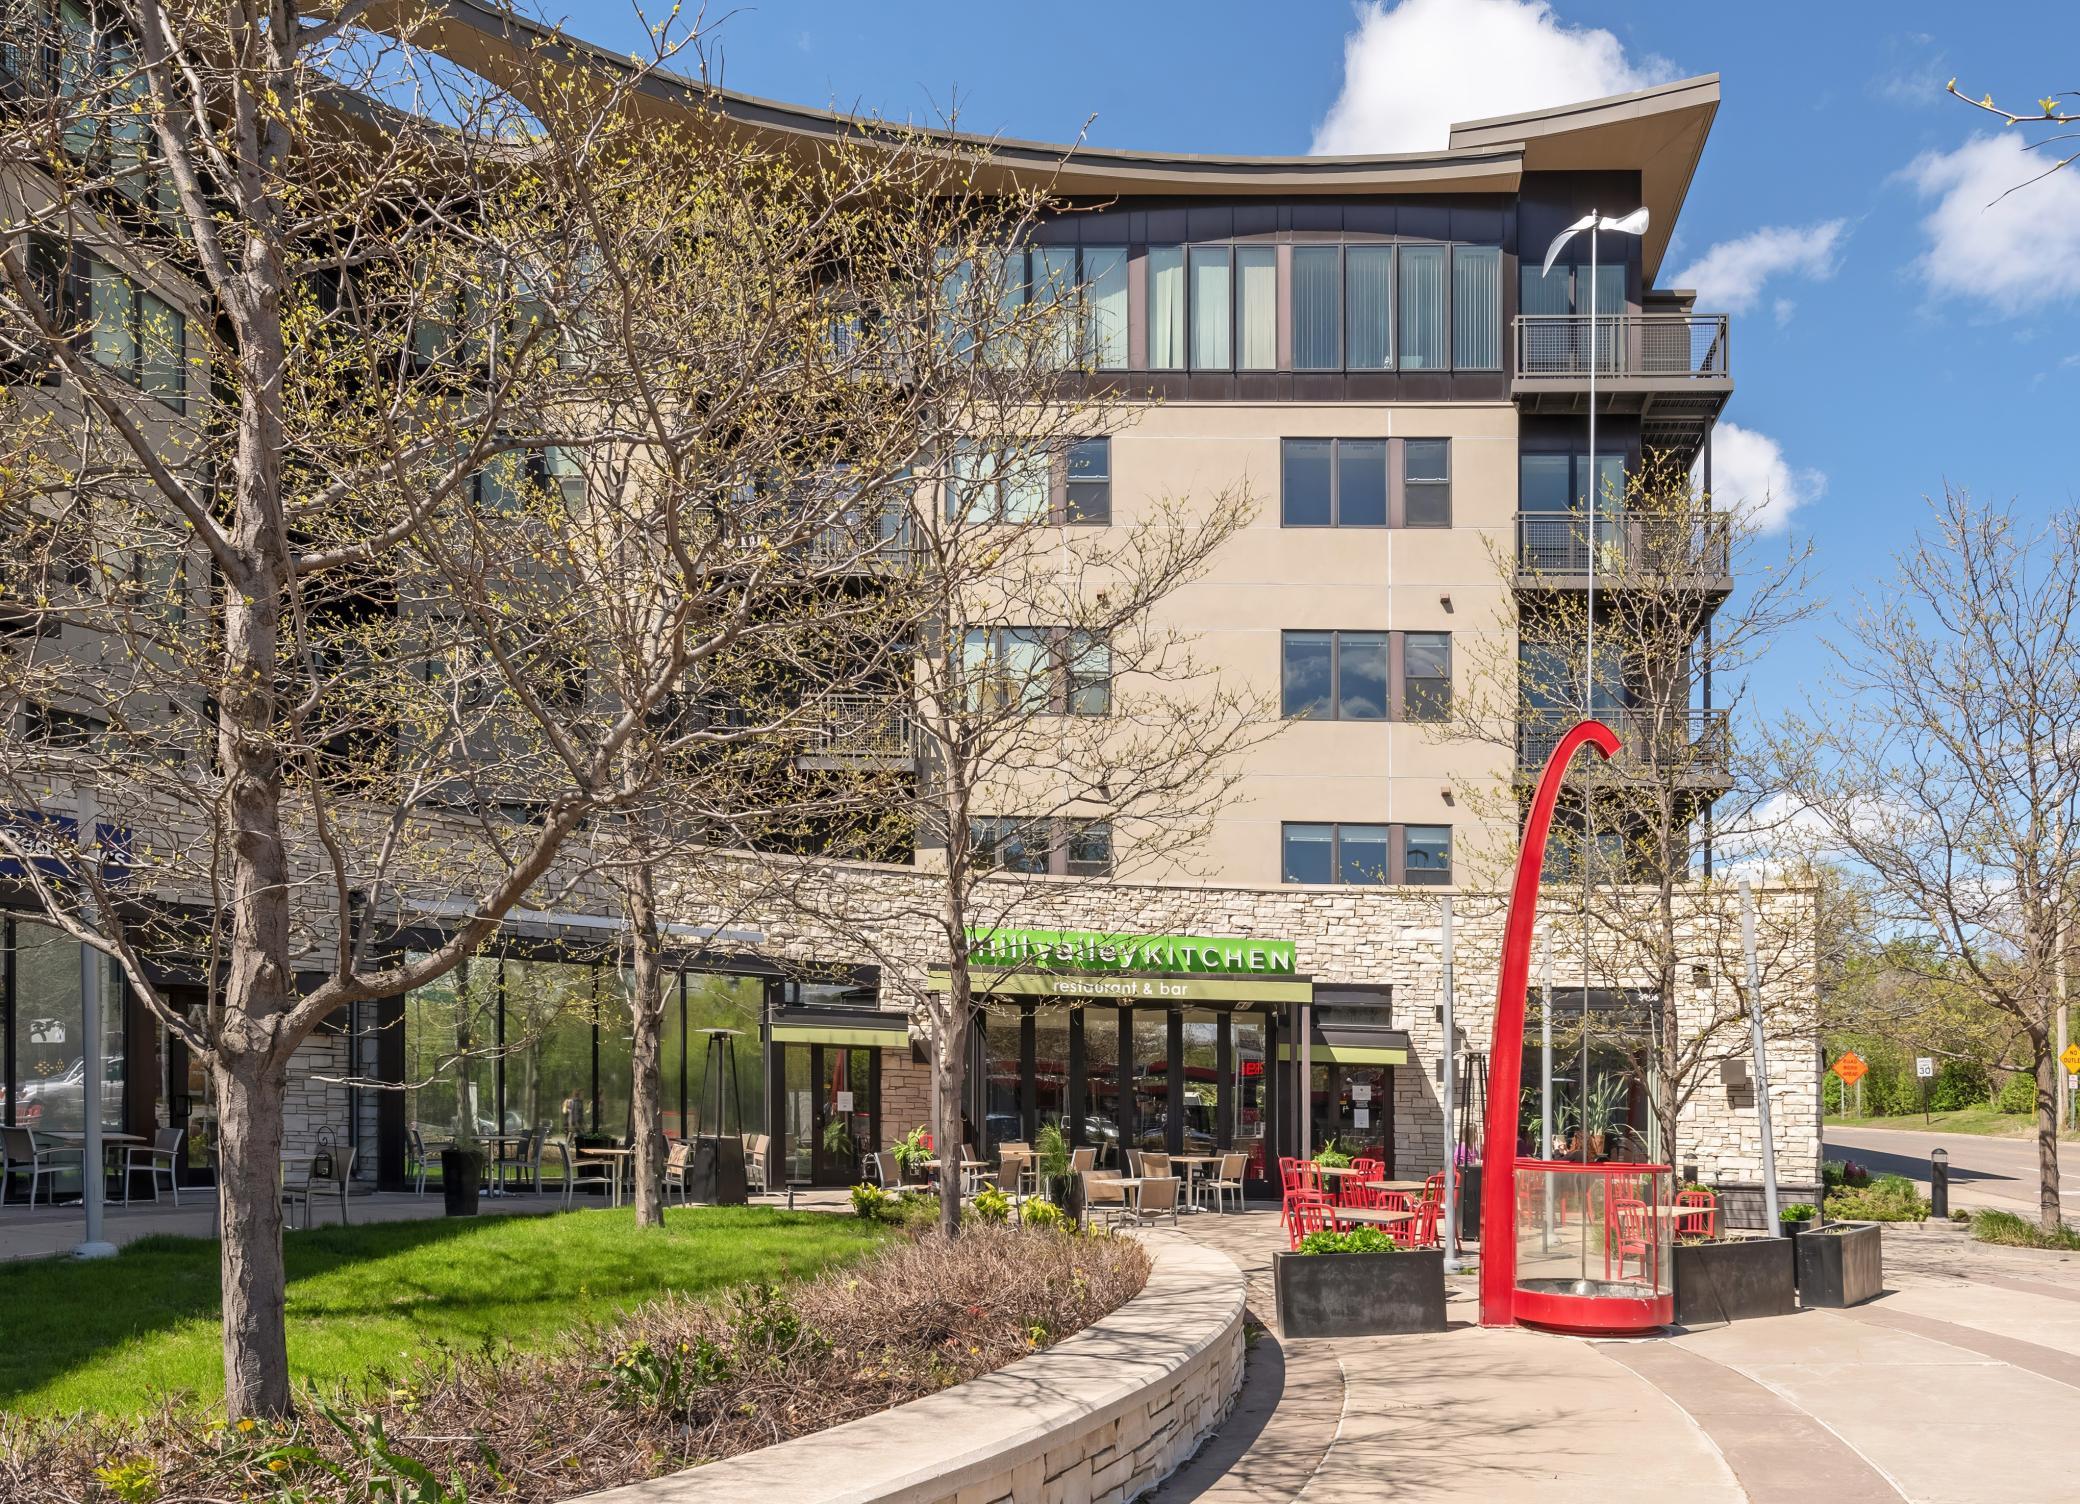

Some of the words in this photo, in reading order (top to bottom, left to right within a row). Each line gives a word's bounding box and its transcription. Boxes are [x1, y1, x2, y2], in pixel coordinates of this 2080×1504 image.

[1145, 944, 1289, 970] KITCHEN
[1053, 980, 1138, 995] restaurant
[1143, 983, 1153, 995] &
[1160, 982, 1188, 996] bar
[1919, 1066, 1931, 1075] 30
